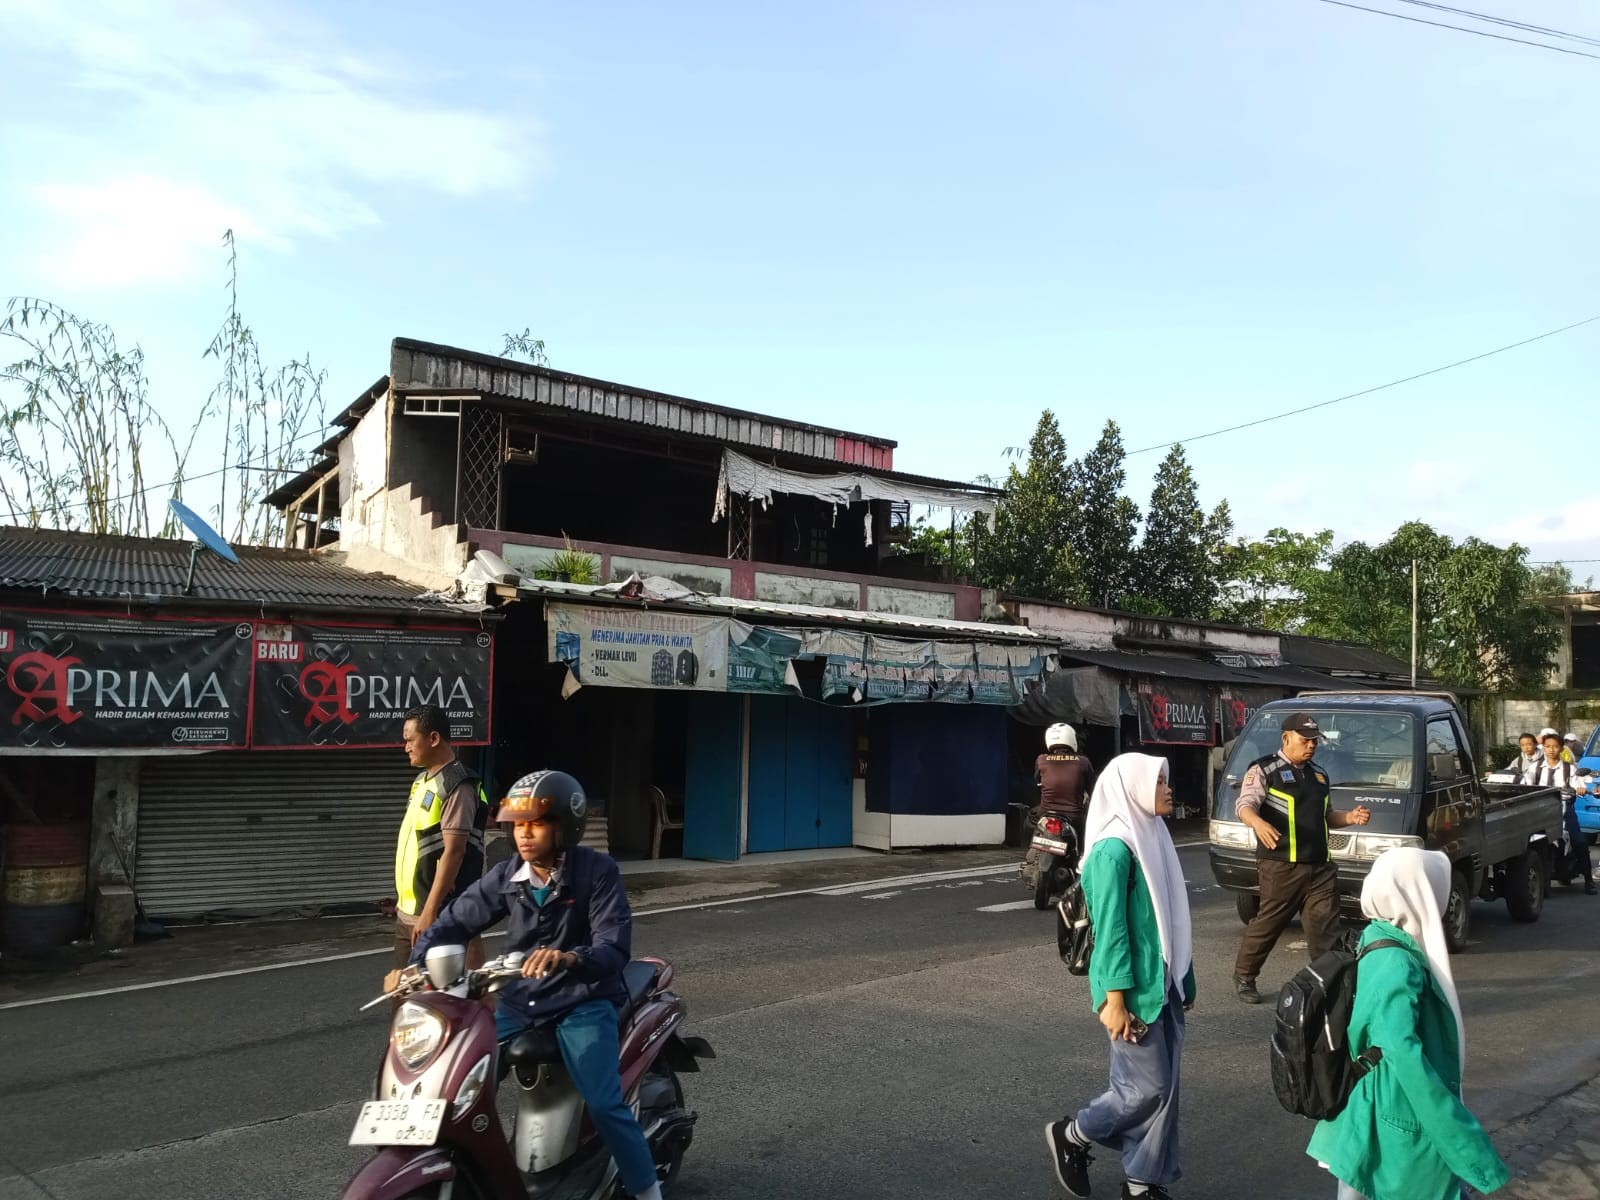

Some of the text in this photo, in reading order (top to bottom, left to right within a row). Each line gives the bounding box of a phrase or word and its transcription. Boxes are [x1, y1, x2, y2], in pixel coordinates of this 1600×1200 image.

[591, 629, 625, 644] MENERIMA
[625, 633, 650, 646] JAHITAN
[671, 636, 693, 649] WANITA
[257, 643, 299, 660] BARU
[66, 668, 230, 708] PRIMA
[345, 675, 474, 709] PRIMA
[95, 711, 230, 719] HADIR DALAM KEMASAN KERTAS
[1165, 703, 1207, 724] PRIMA
